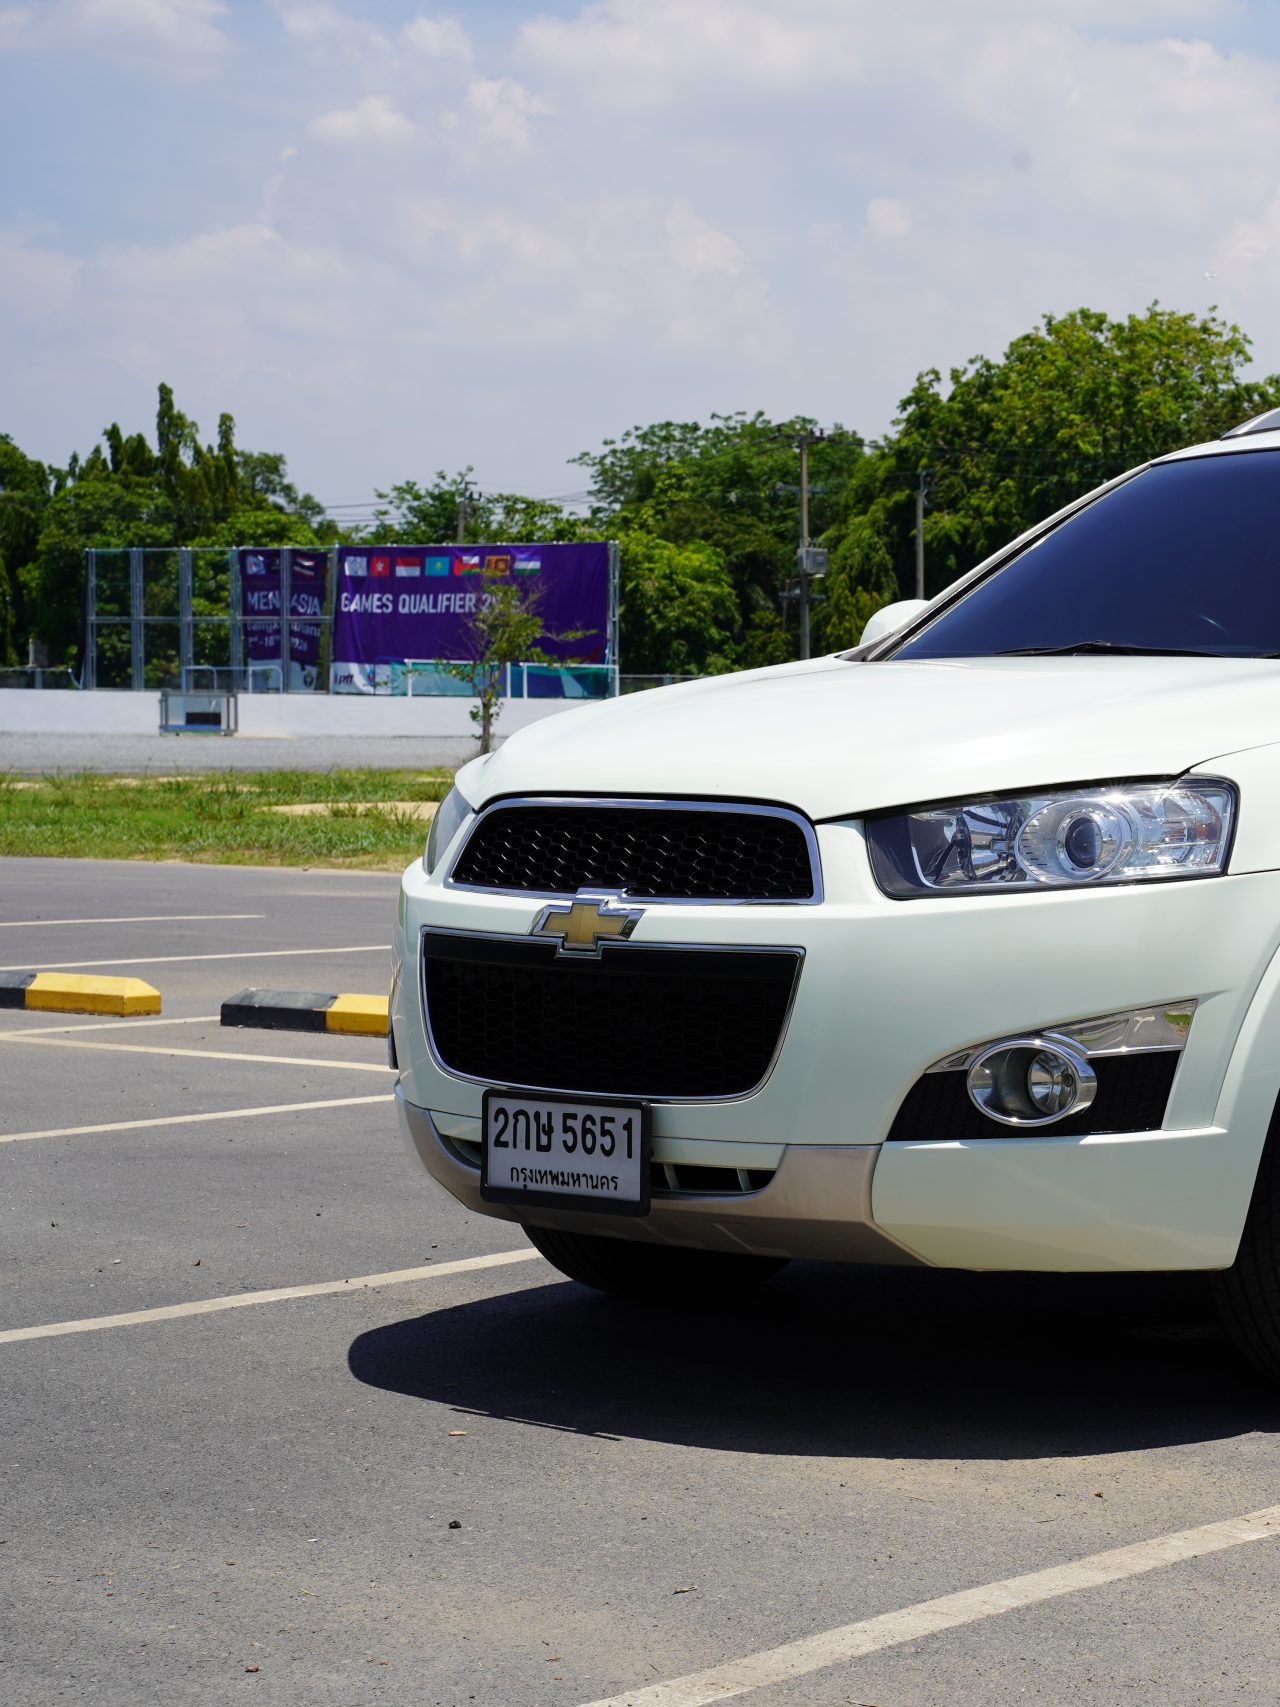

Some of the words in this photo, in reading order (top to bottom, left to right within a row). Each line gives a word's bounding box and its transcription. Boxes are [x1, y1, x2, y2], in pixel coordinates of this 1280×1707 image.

[341, 592, 393, 613] GAMES
[399, 593, 476, 614] QUALIFIER
[493, 1107, 554, 1152] 2กษ
[562, 1112, 633, 1159] 5651
[510, 1166, 619, 1191] กรุงเทพมหานคร
